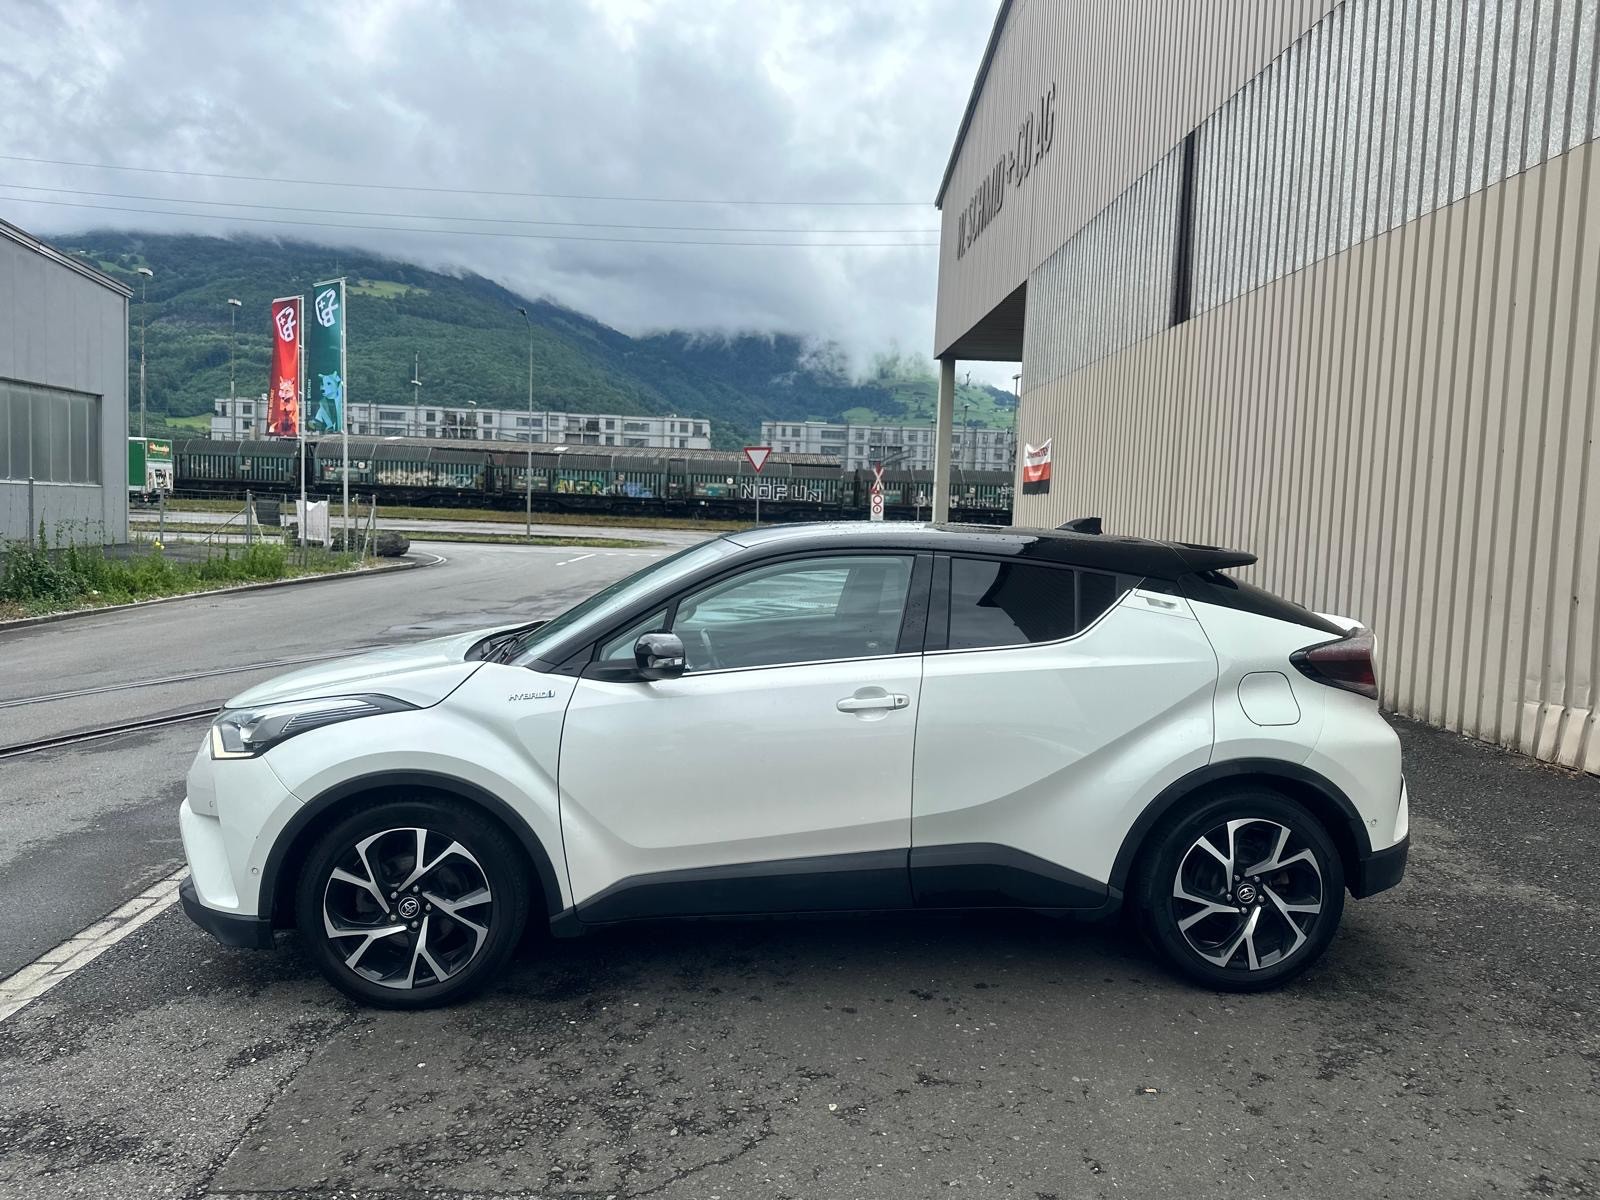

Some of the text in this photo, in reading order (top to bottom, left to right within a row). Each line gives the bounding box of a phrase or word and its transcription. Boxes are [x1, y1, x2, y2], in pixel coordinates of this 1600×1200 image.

[967, 153, 1006, 248] SCHMID
[1015, 111, 1034, 188] CO
[1034, 81, 1057, 167] AG
[508, 690, 548, 702] HYBRID
